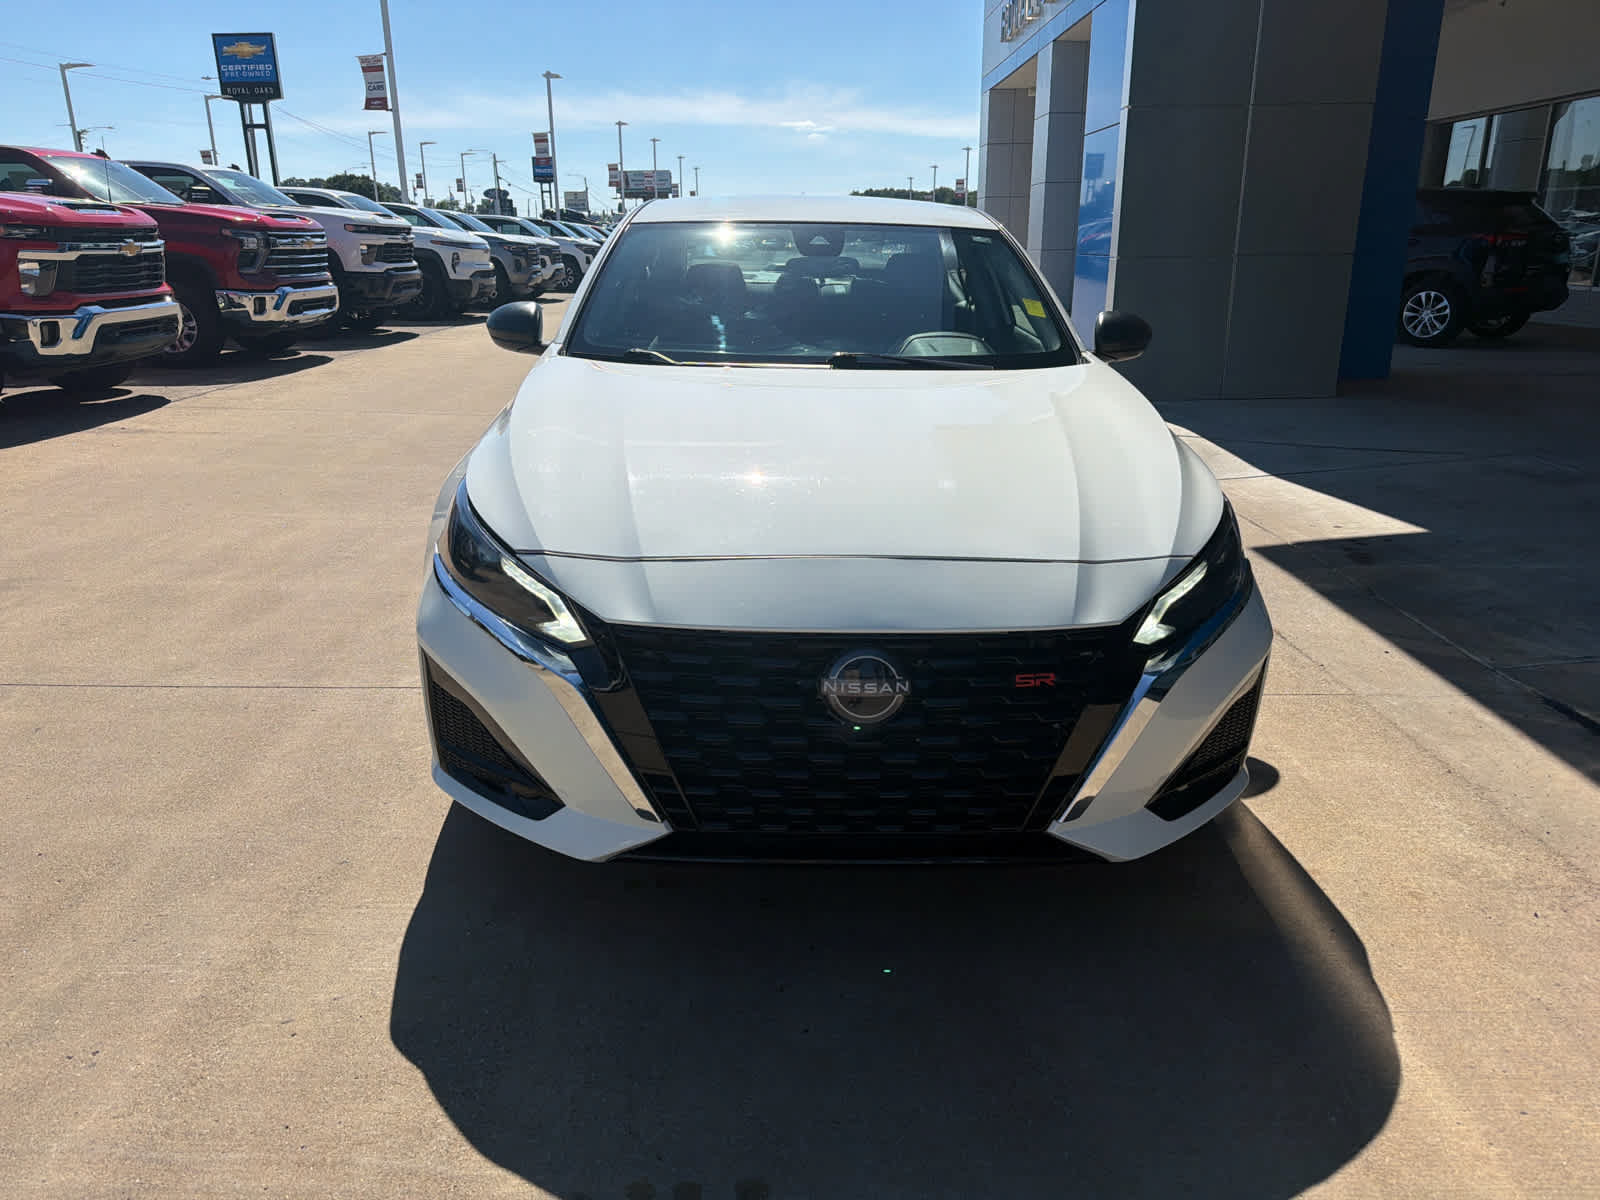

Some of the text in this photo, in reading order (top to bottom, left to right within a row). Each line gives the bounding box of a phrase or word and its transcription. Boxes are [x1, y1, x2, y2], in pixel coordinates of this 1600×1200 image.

[220, 63, 273, 71] CERTIFIED
[226, 87, 251, 95] ROYAL
[1015, 673, 1056, 688] SR
[823, 681, 909, 694] NISSAN
